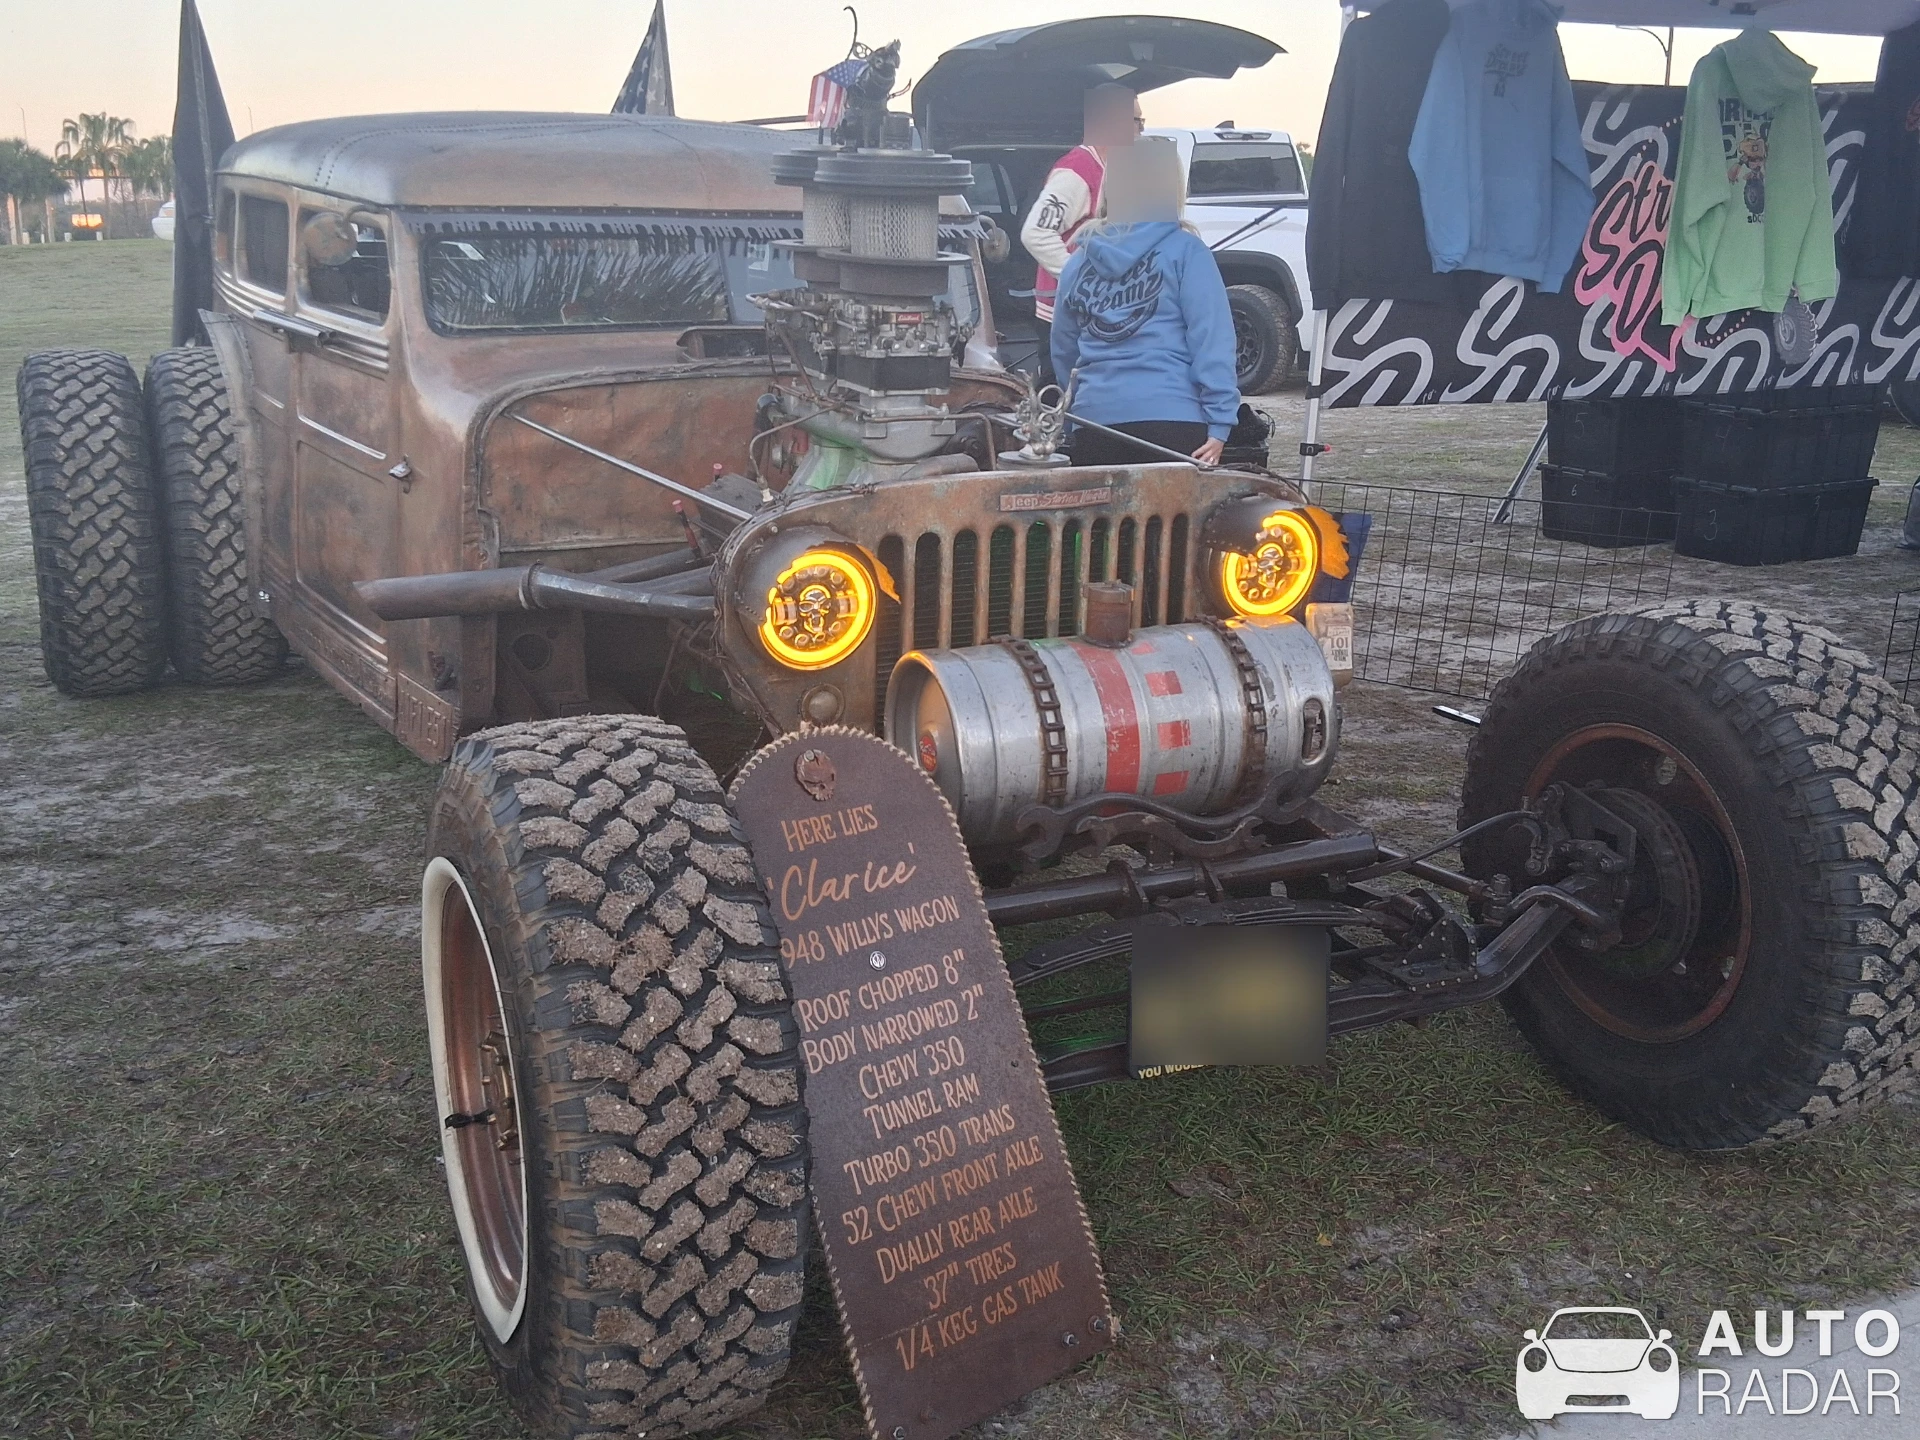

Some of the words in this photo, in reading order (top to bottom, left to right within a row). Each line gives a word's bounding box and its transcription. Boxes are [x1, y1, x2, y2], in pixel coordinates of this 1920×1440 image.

[1331, 637, 1349, 649] 101
[781, 813, 836, 852] HERE
[838, 804, 878, 836] LIES
[780, 930, 825, 969] 948
[826, 911, 894, 956] WILLYS
[894, 895, 960, 935] WAGON
[798, 988, 851, 1033] ROOF
[858, 962, 939, 1011] CHOPPED
[944, 949, 964, 986] 8"
[802, 1027, 856, 1074] BODY
[861, 998, 959, 1052] NARROWED
[960, 984, 984, 1021] 2"
[858, 1055, 919, 1100] CHEVY
[923, 1036, 965, 1077] 350
[1138, 1066, 1162, 1080] YOU
[863, 1088, 942, 1140] TUNNEL
[943, 1073, 981, 1109] RAM
[844, 1145, 910, 1195] TURBO
[913, 1125, 956, 1169] 350
[958, 1104, 1016, 1146] TRANS
[842, 1206, 873, 1245] 52
[876, 1176, 937, 1232] CHEVY
[942, 1153, 999, 1201] FRONT
[1005, 1136, 1044, 1177] AXLE
[876, 1223, 944, 1284] DUALLY
[949, 1206, 994, 1249] REAR
[998, 1187, 1038, 1228] AXLE
[924, 1261, 960, 1311] 37"
[965, 1242, 1018, 1286] TIRES
[896, 1326, 935, 1371] 1/4
[939, 1305, 978, 1349] KEG
[982, 1286, 1018, 1325] GAS
[1018, 1261, 1065, 1305] TANK
